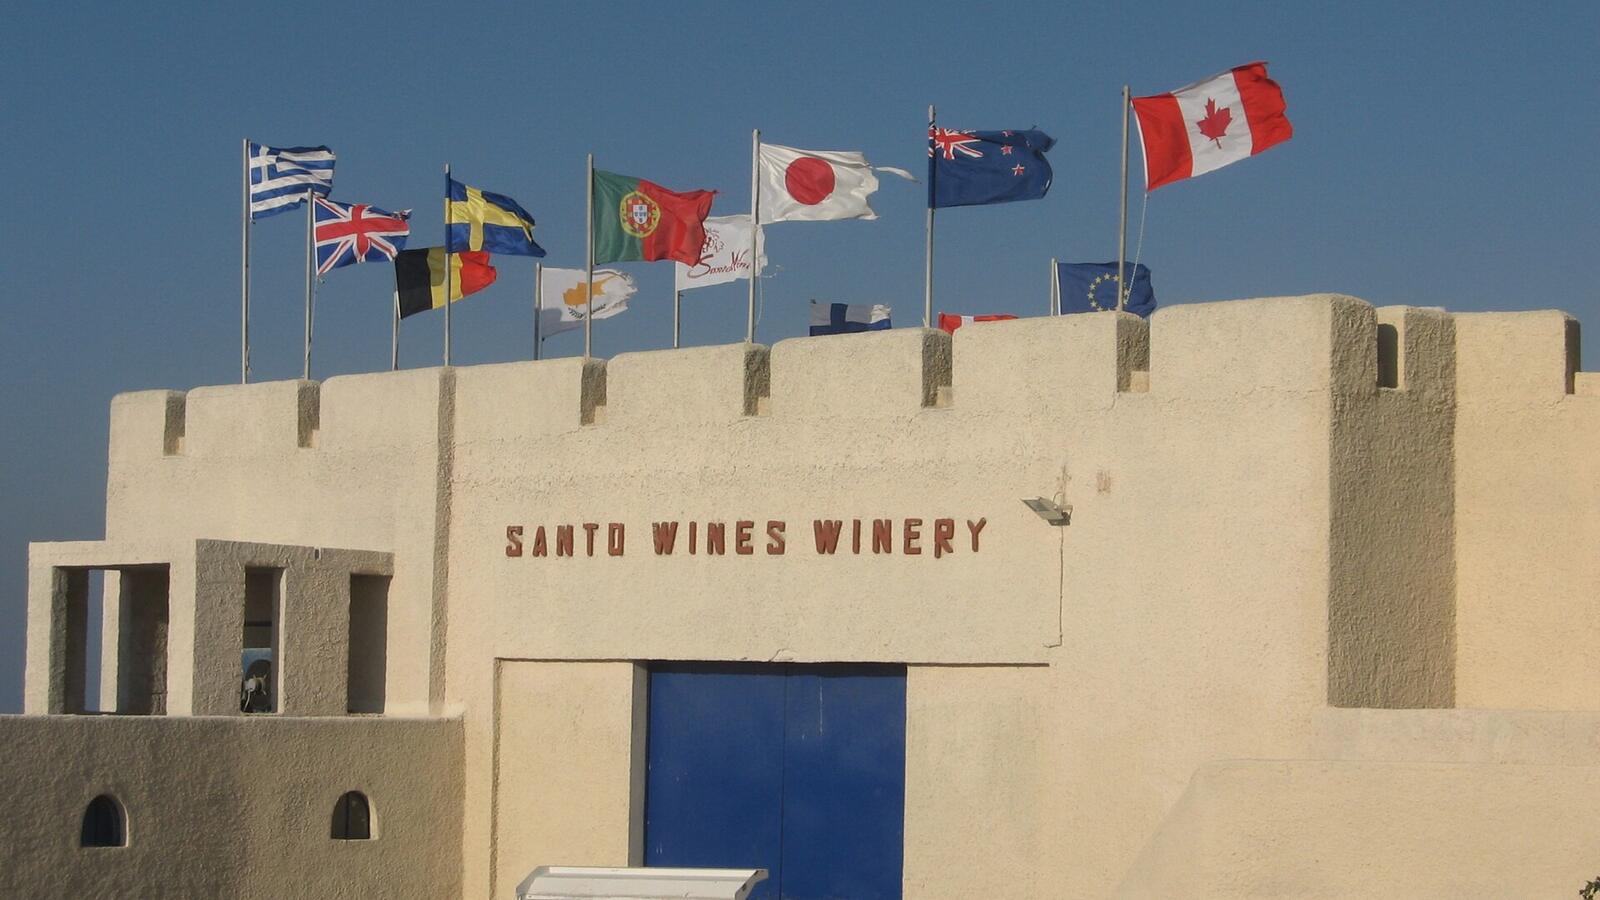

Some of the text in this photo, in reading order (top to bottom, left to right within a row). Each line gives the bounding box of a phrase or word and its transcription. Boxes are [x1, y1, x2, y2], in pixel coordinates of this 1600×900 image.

[506, 517, 987, 559] SANTO WINES WINERY
